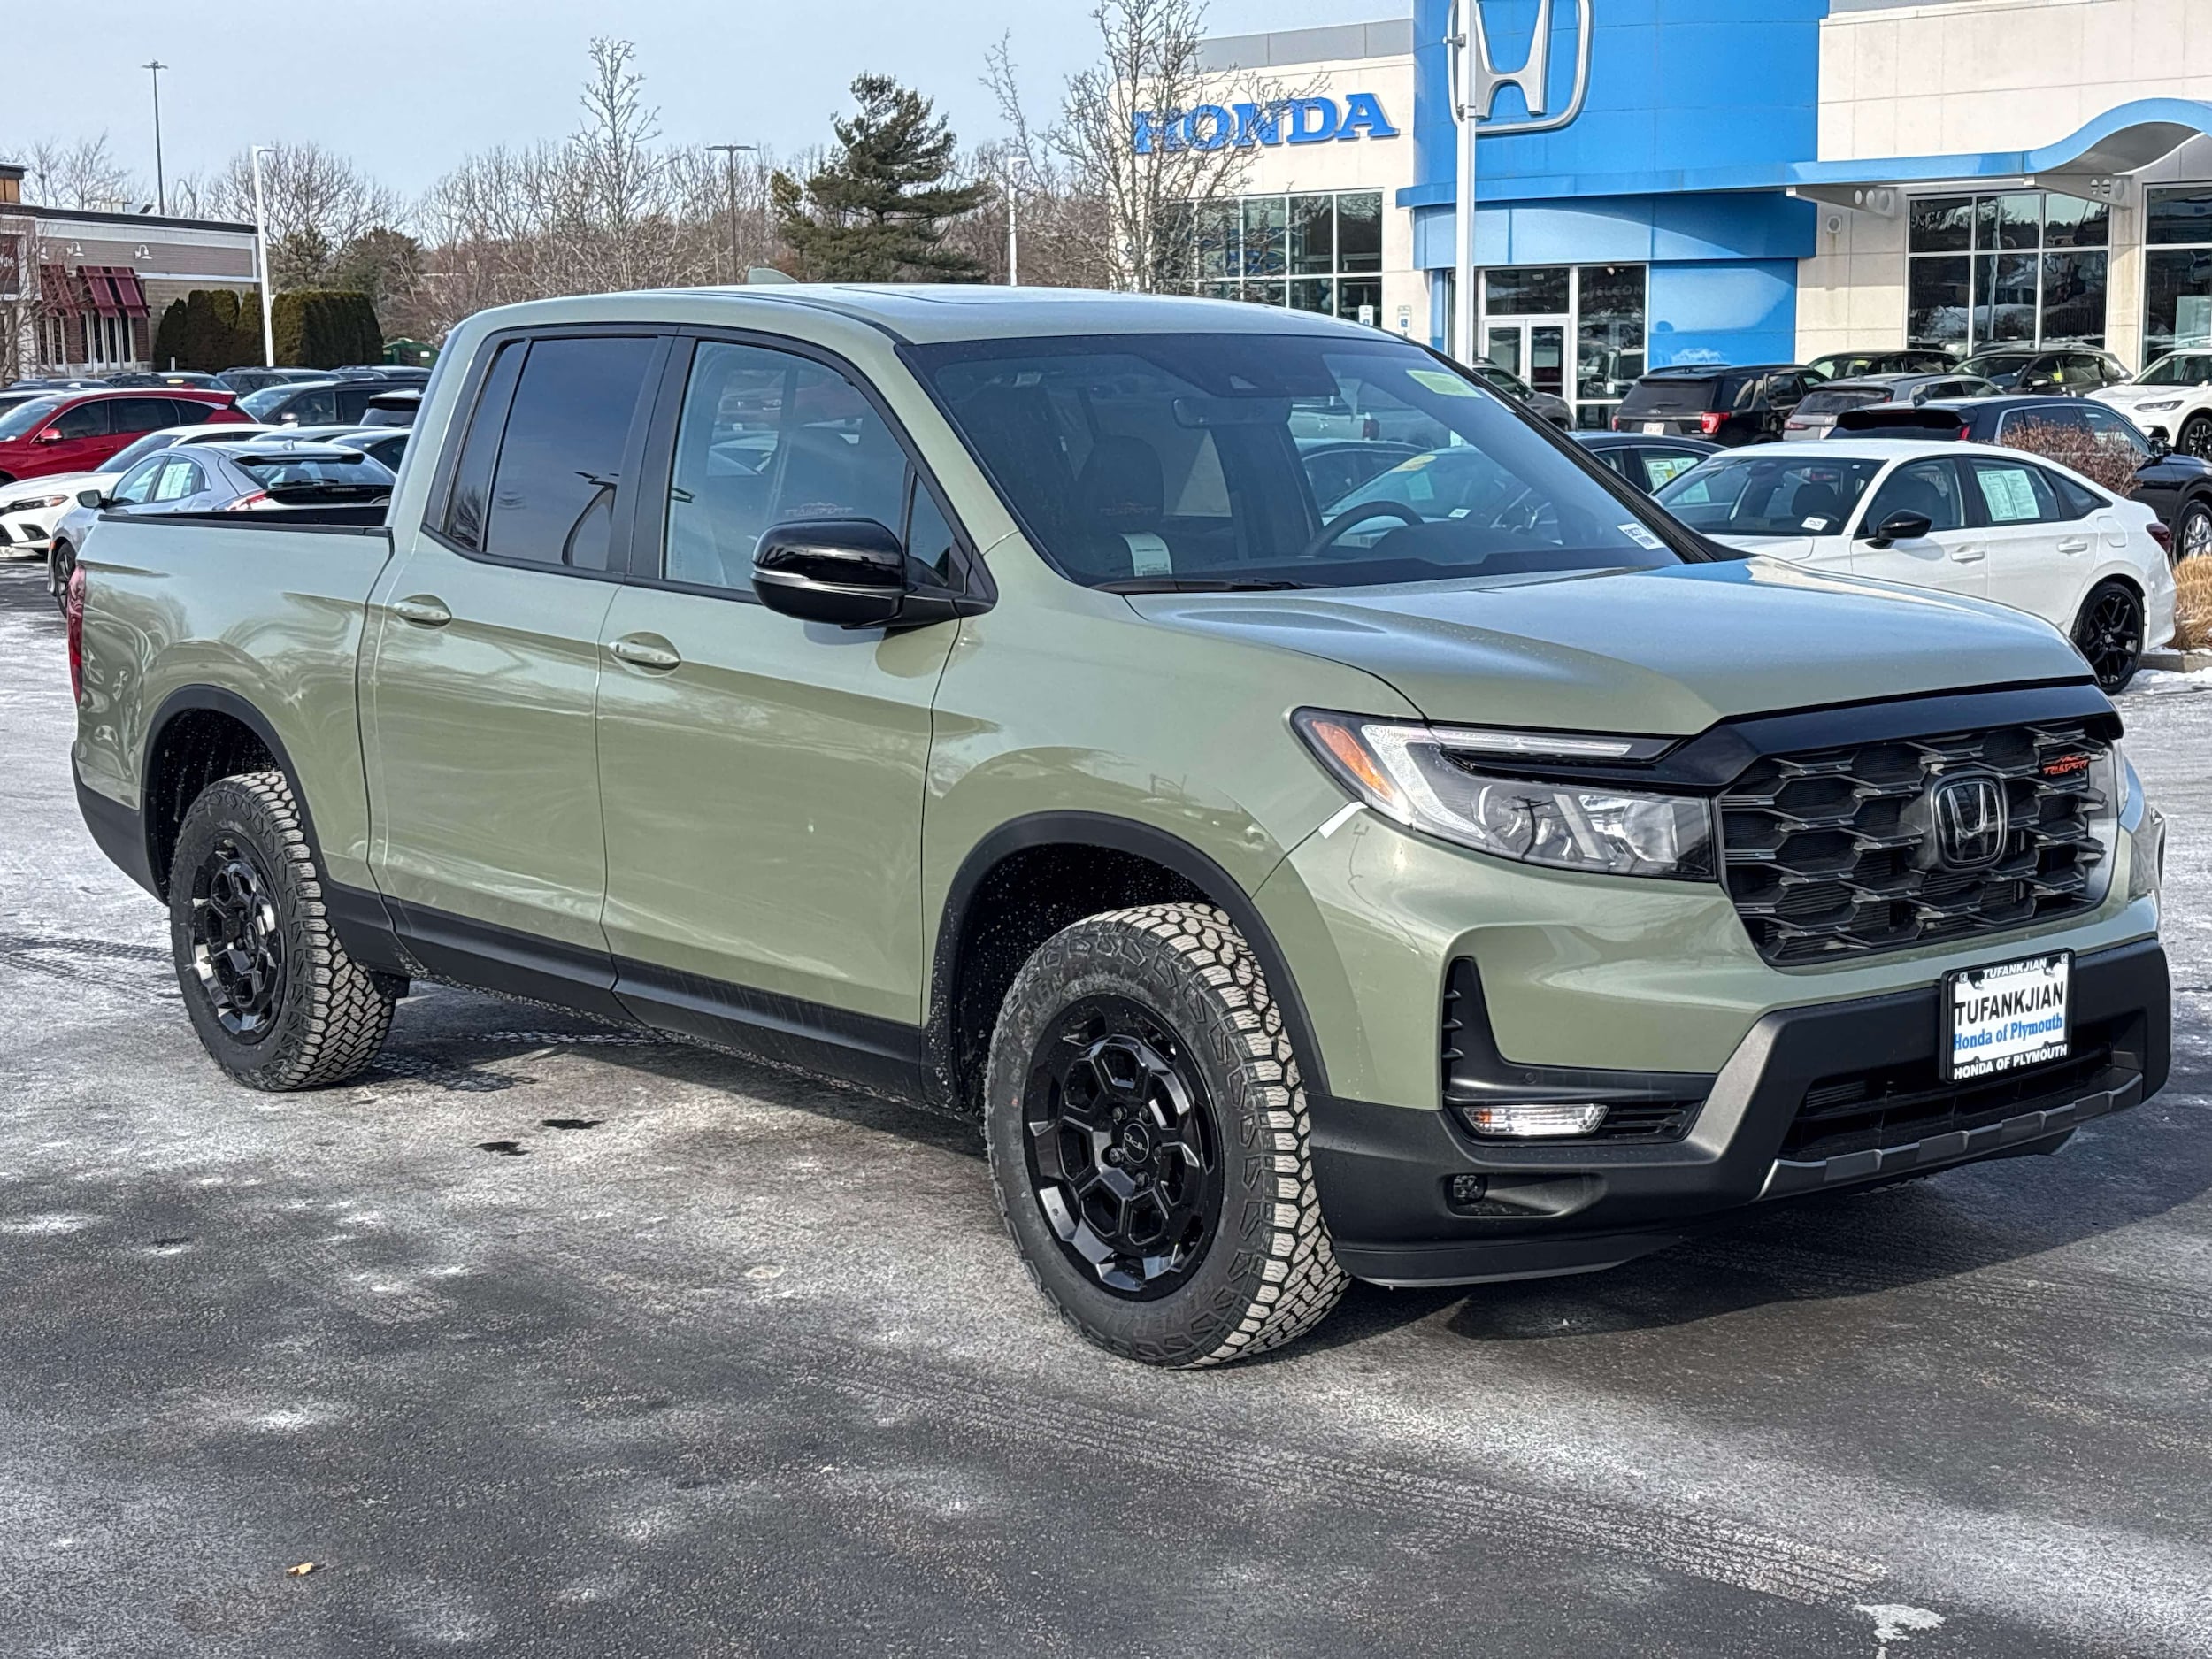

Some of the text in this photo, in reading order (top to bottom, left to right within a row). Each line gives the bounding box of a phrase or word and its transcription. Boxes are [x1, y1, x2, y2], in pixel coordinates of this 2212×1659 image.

[1133, 92, 1400, 155] HONDA
[1983, 958, 2047, 979] TUFANKJIAN
[1954, 981, 2063, 1026] TUFANKJIAN
[1954, 1012, 2063, 1051] Honda of Plymouth
[1954, 1044, 2067, 1080] HONDA OF PLYMOUTH
